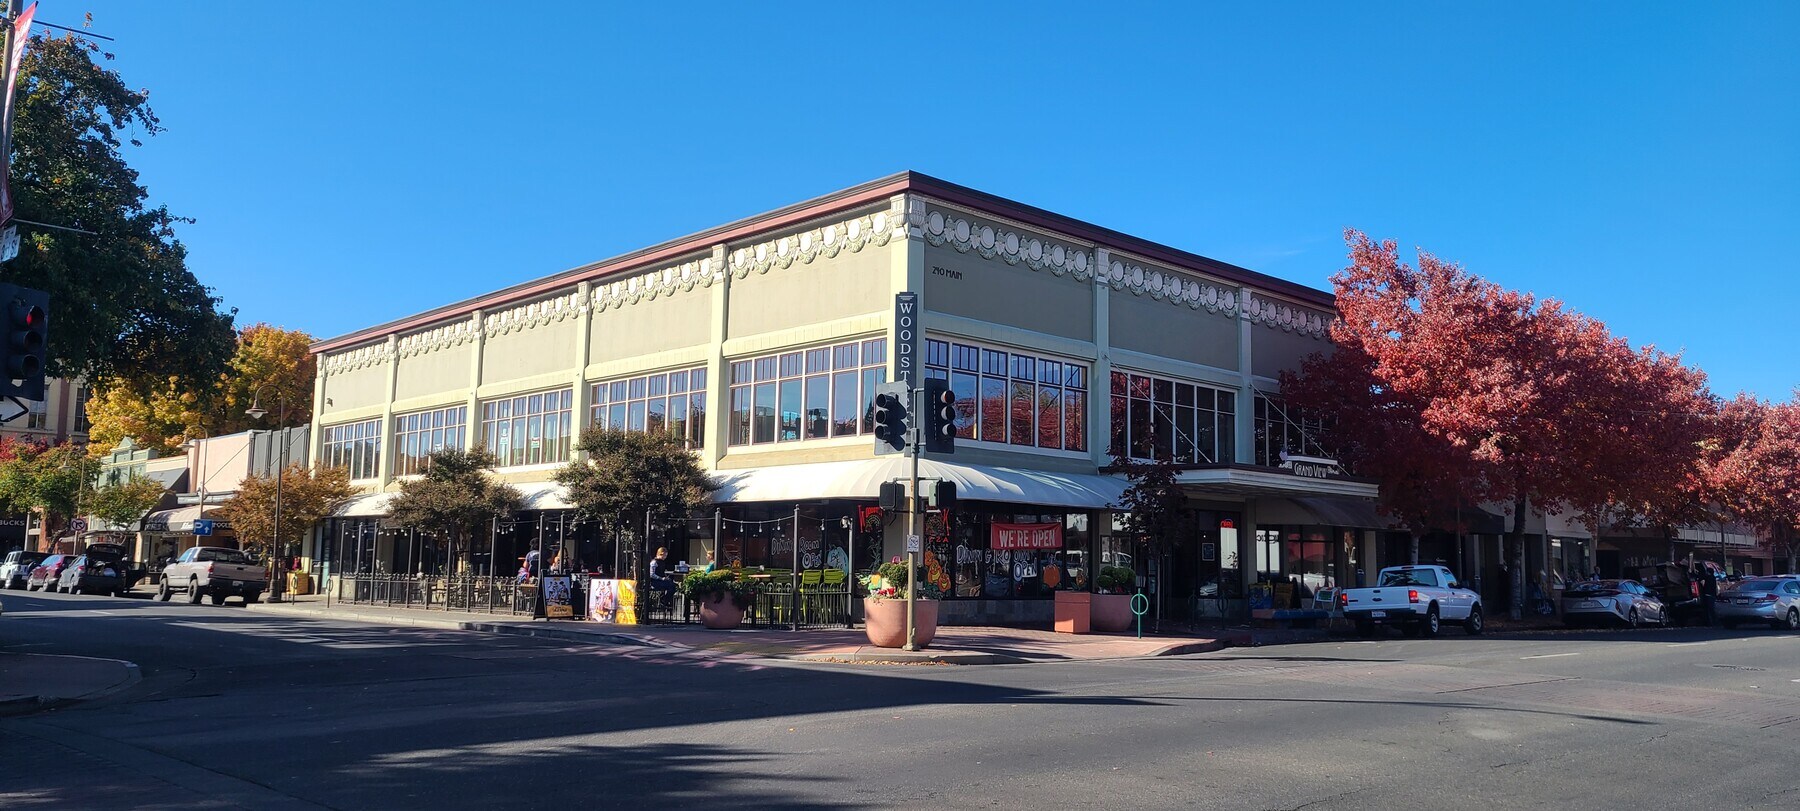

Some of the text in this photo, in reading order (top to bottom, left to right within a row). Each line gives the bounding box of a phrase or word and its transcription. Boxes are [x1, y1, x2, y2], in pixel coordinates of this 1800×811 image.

[932, 266, 963, 281] 240 MAIN
[1294, 462, 1327, 478] GRAND VIEW
[194, 521, 204, 533] P
[999, 529, 1056, 549] WE'RE OPEN
